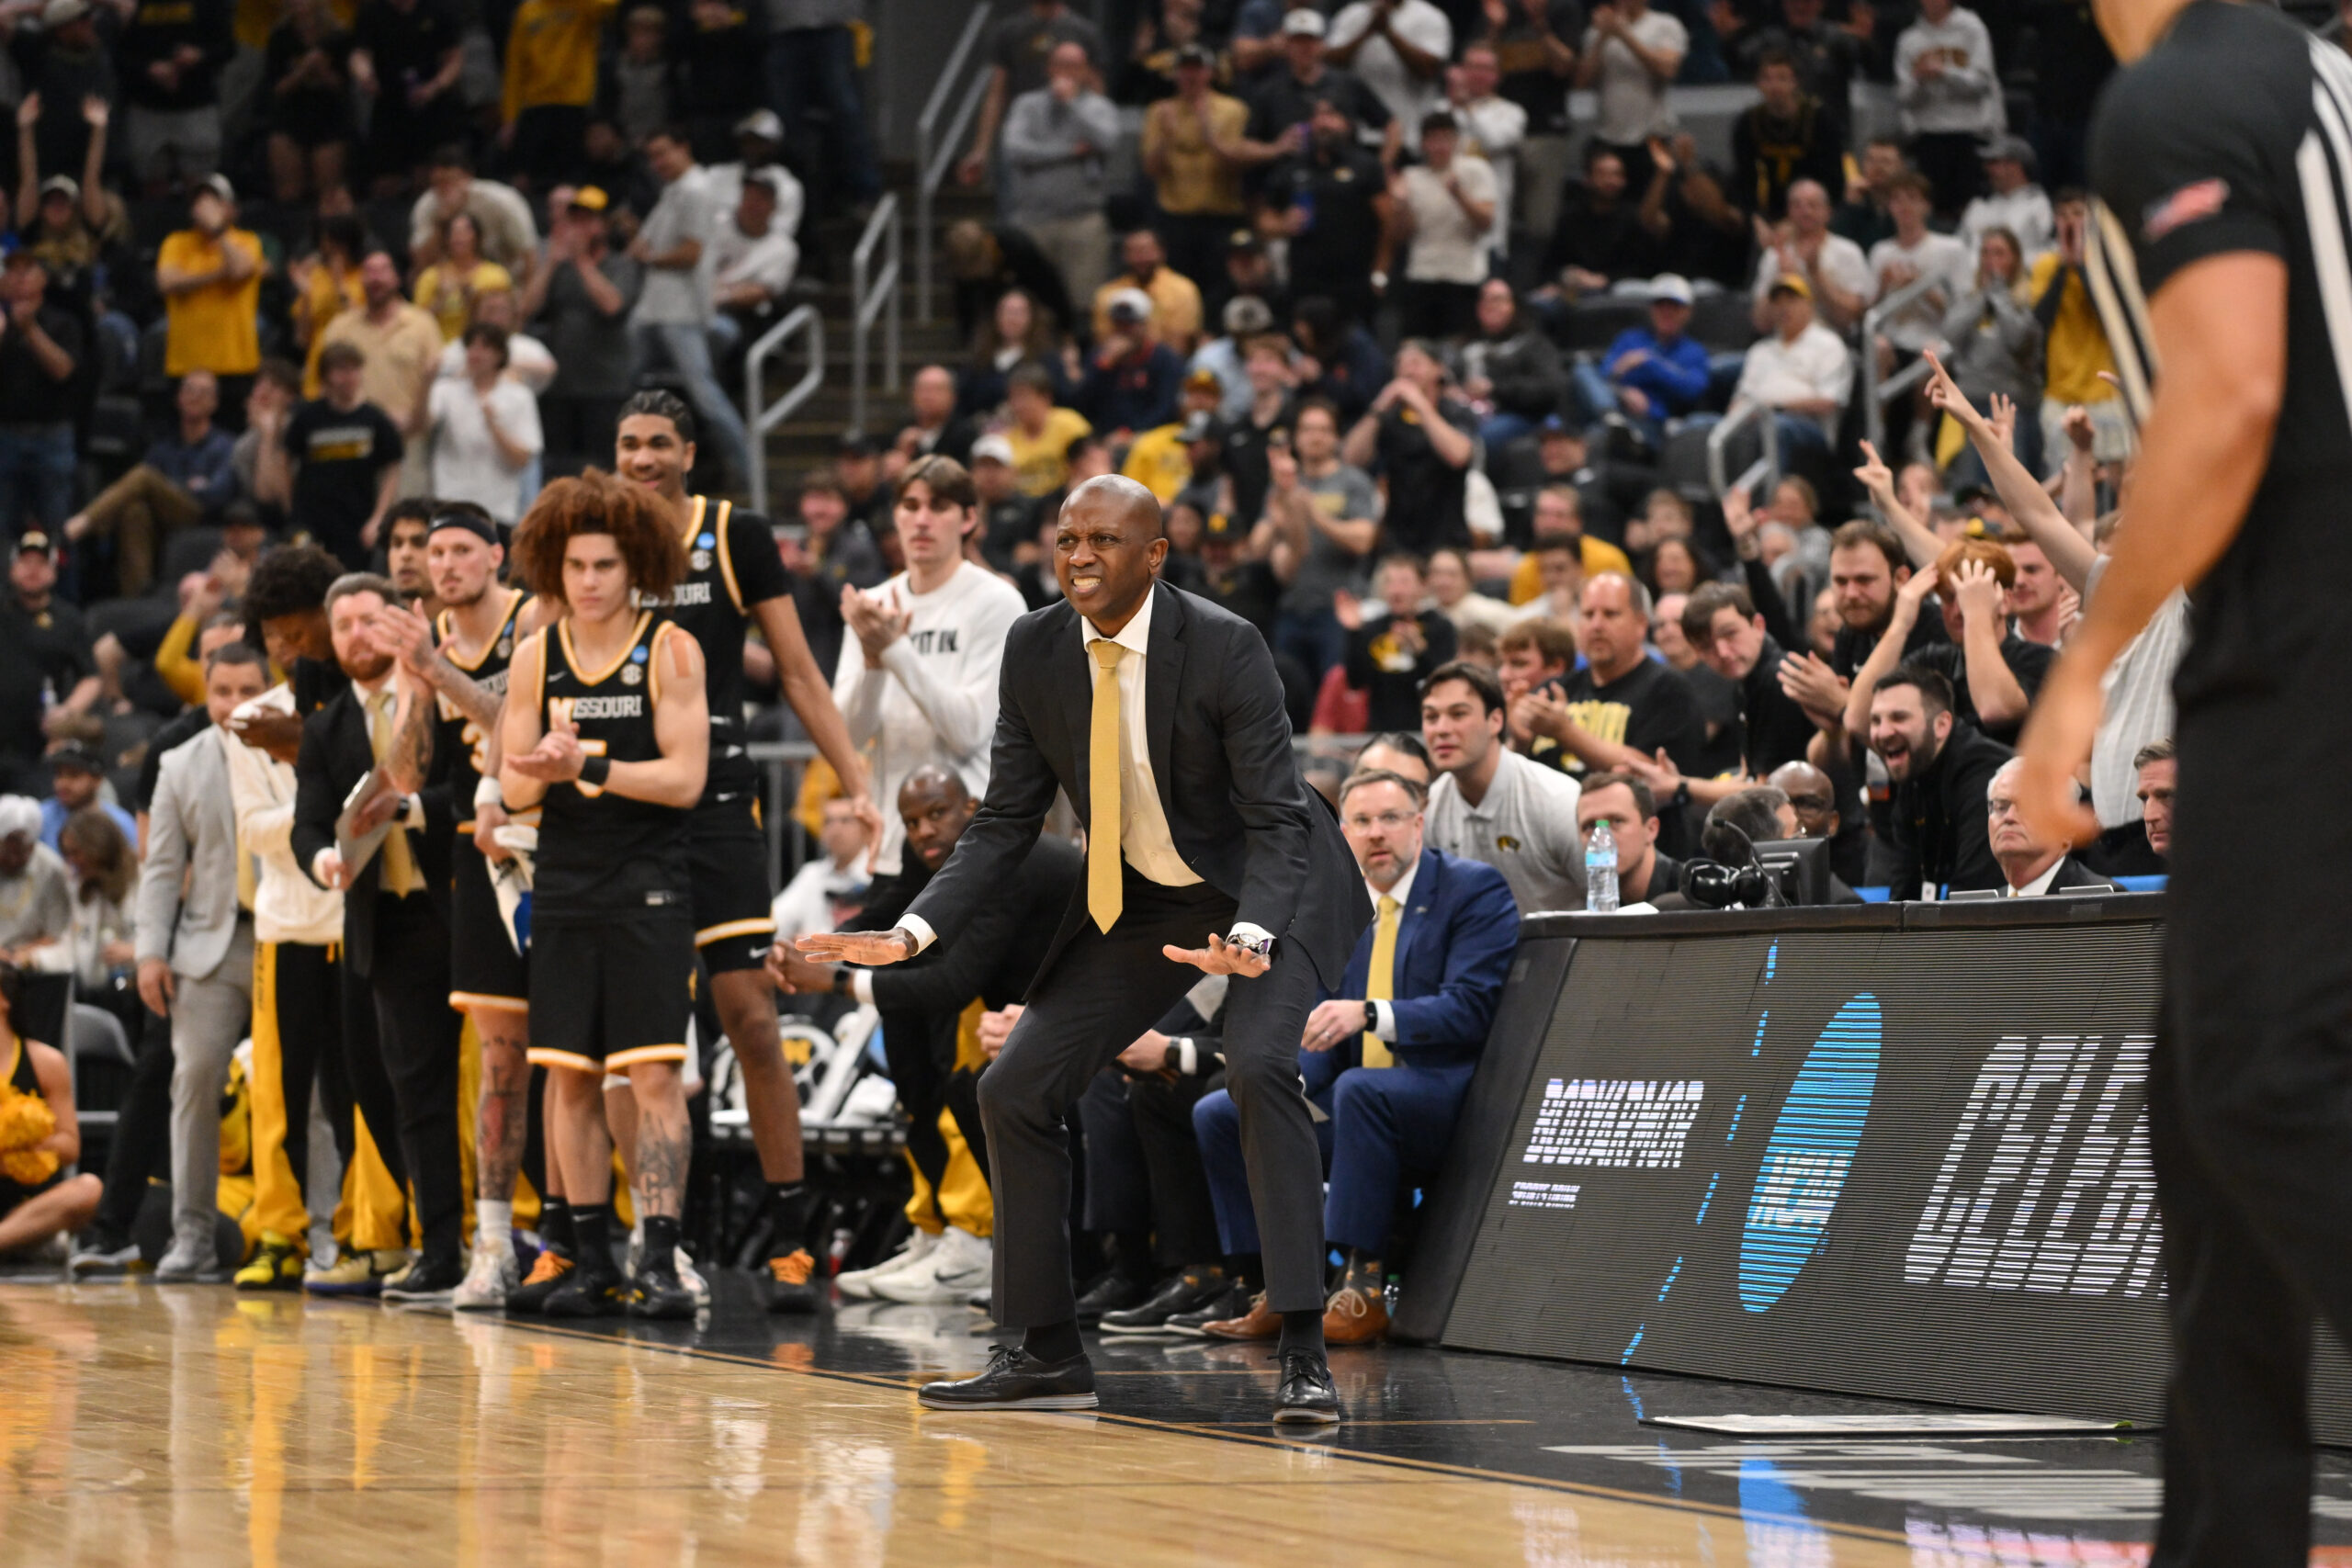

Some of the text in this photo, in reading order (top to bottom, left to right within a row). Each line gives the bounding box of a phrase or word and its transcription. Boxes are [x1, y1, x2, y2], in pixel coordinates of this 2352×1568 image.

[548, 695, 643, 728] MISSOURI
[1522, 1077, 1705, 1168] BODYARMOR
[1749, 1149, 1853, 1230] NCAA
[1904, 1035, 2169, 1299] CELEB
